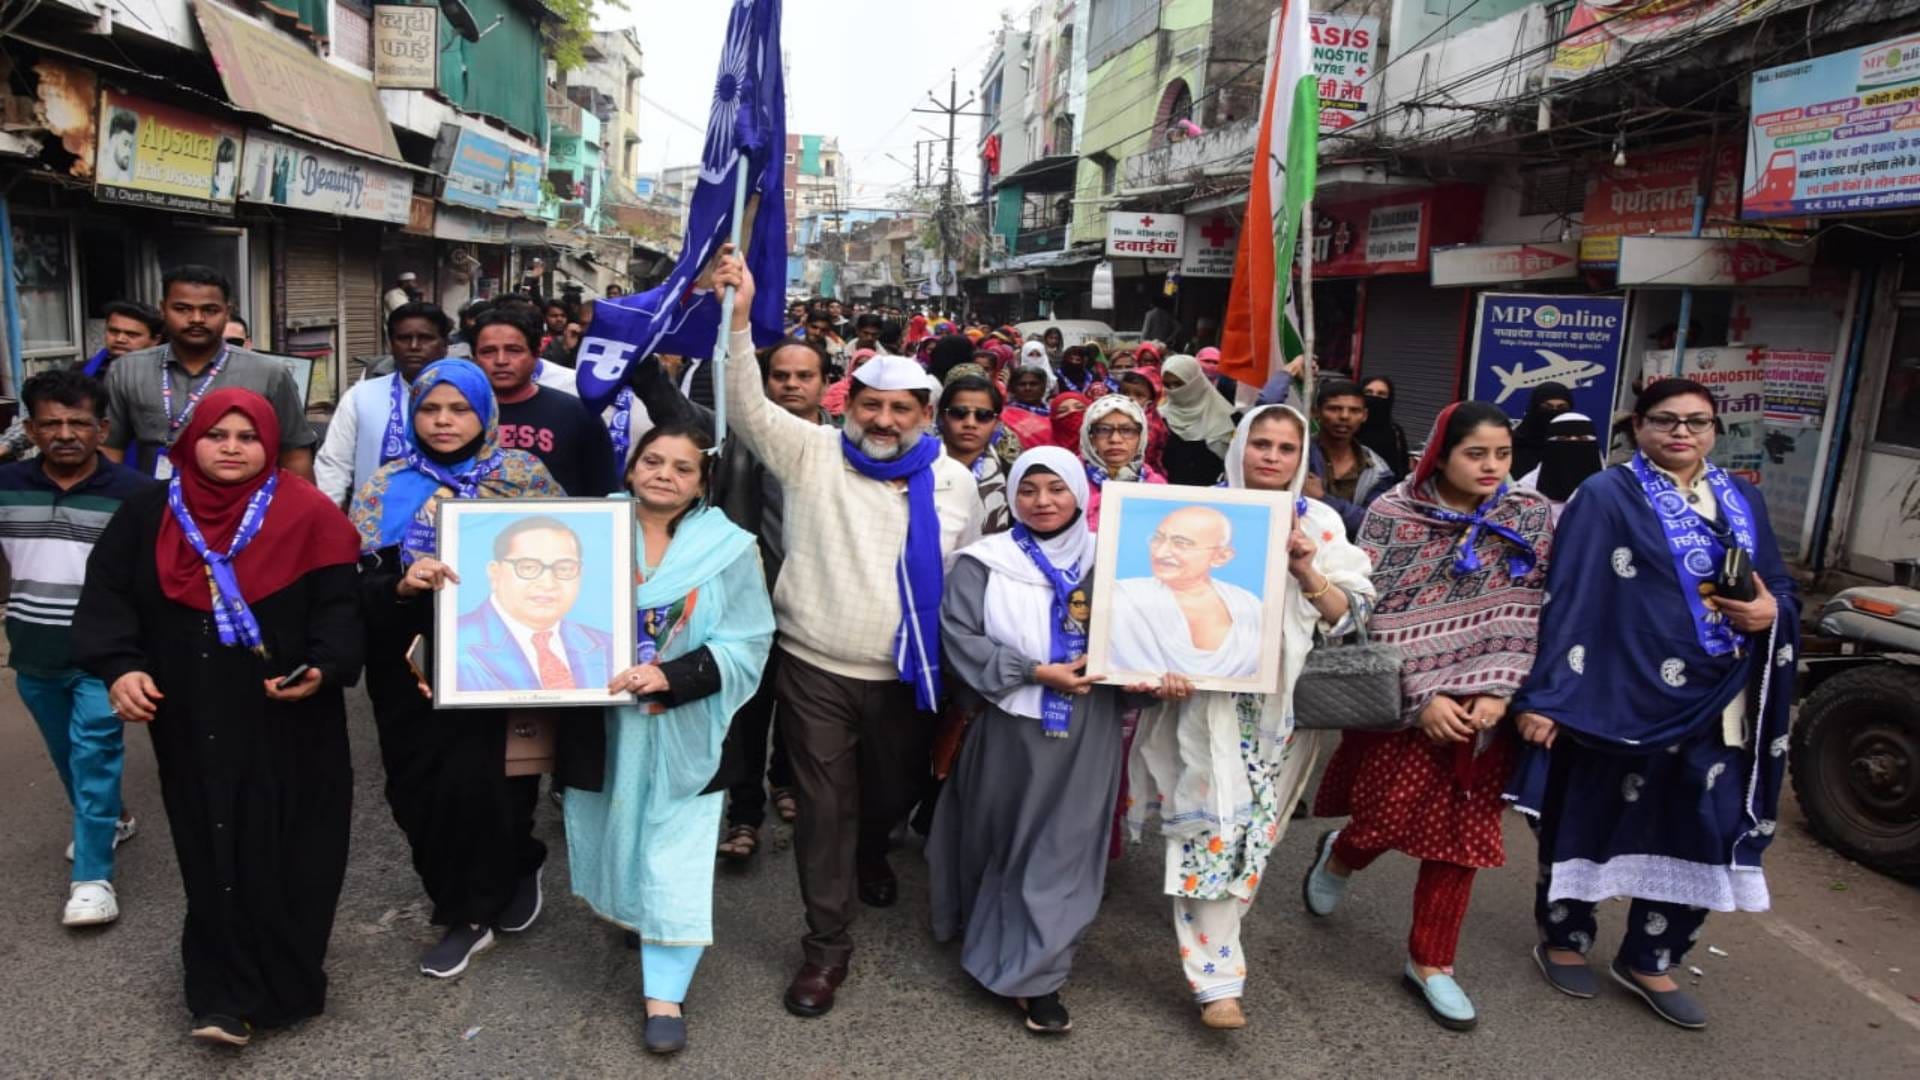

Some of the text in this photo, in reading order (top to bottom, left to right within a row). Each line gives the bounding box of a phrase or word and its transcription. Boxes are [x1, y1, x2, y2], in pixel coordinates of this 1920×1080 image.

[1310, 26, 1369, 48] ASIS
[1313, 47, 1368, 64] NOSTIC
[1314, 63, 1345, 75] NTRE
[140, 115, 213, 162] Apsara
[300, 154, 364, 210] Beautify
[117, 189, 145, 202] Church
[498, 424, 555, 452] ESS
